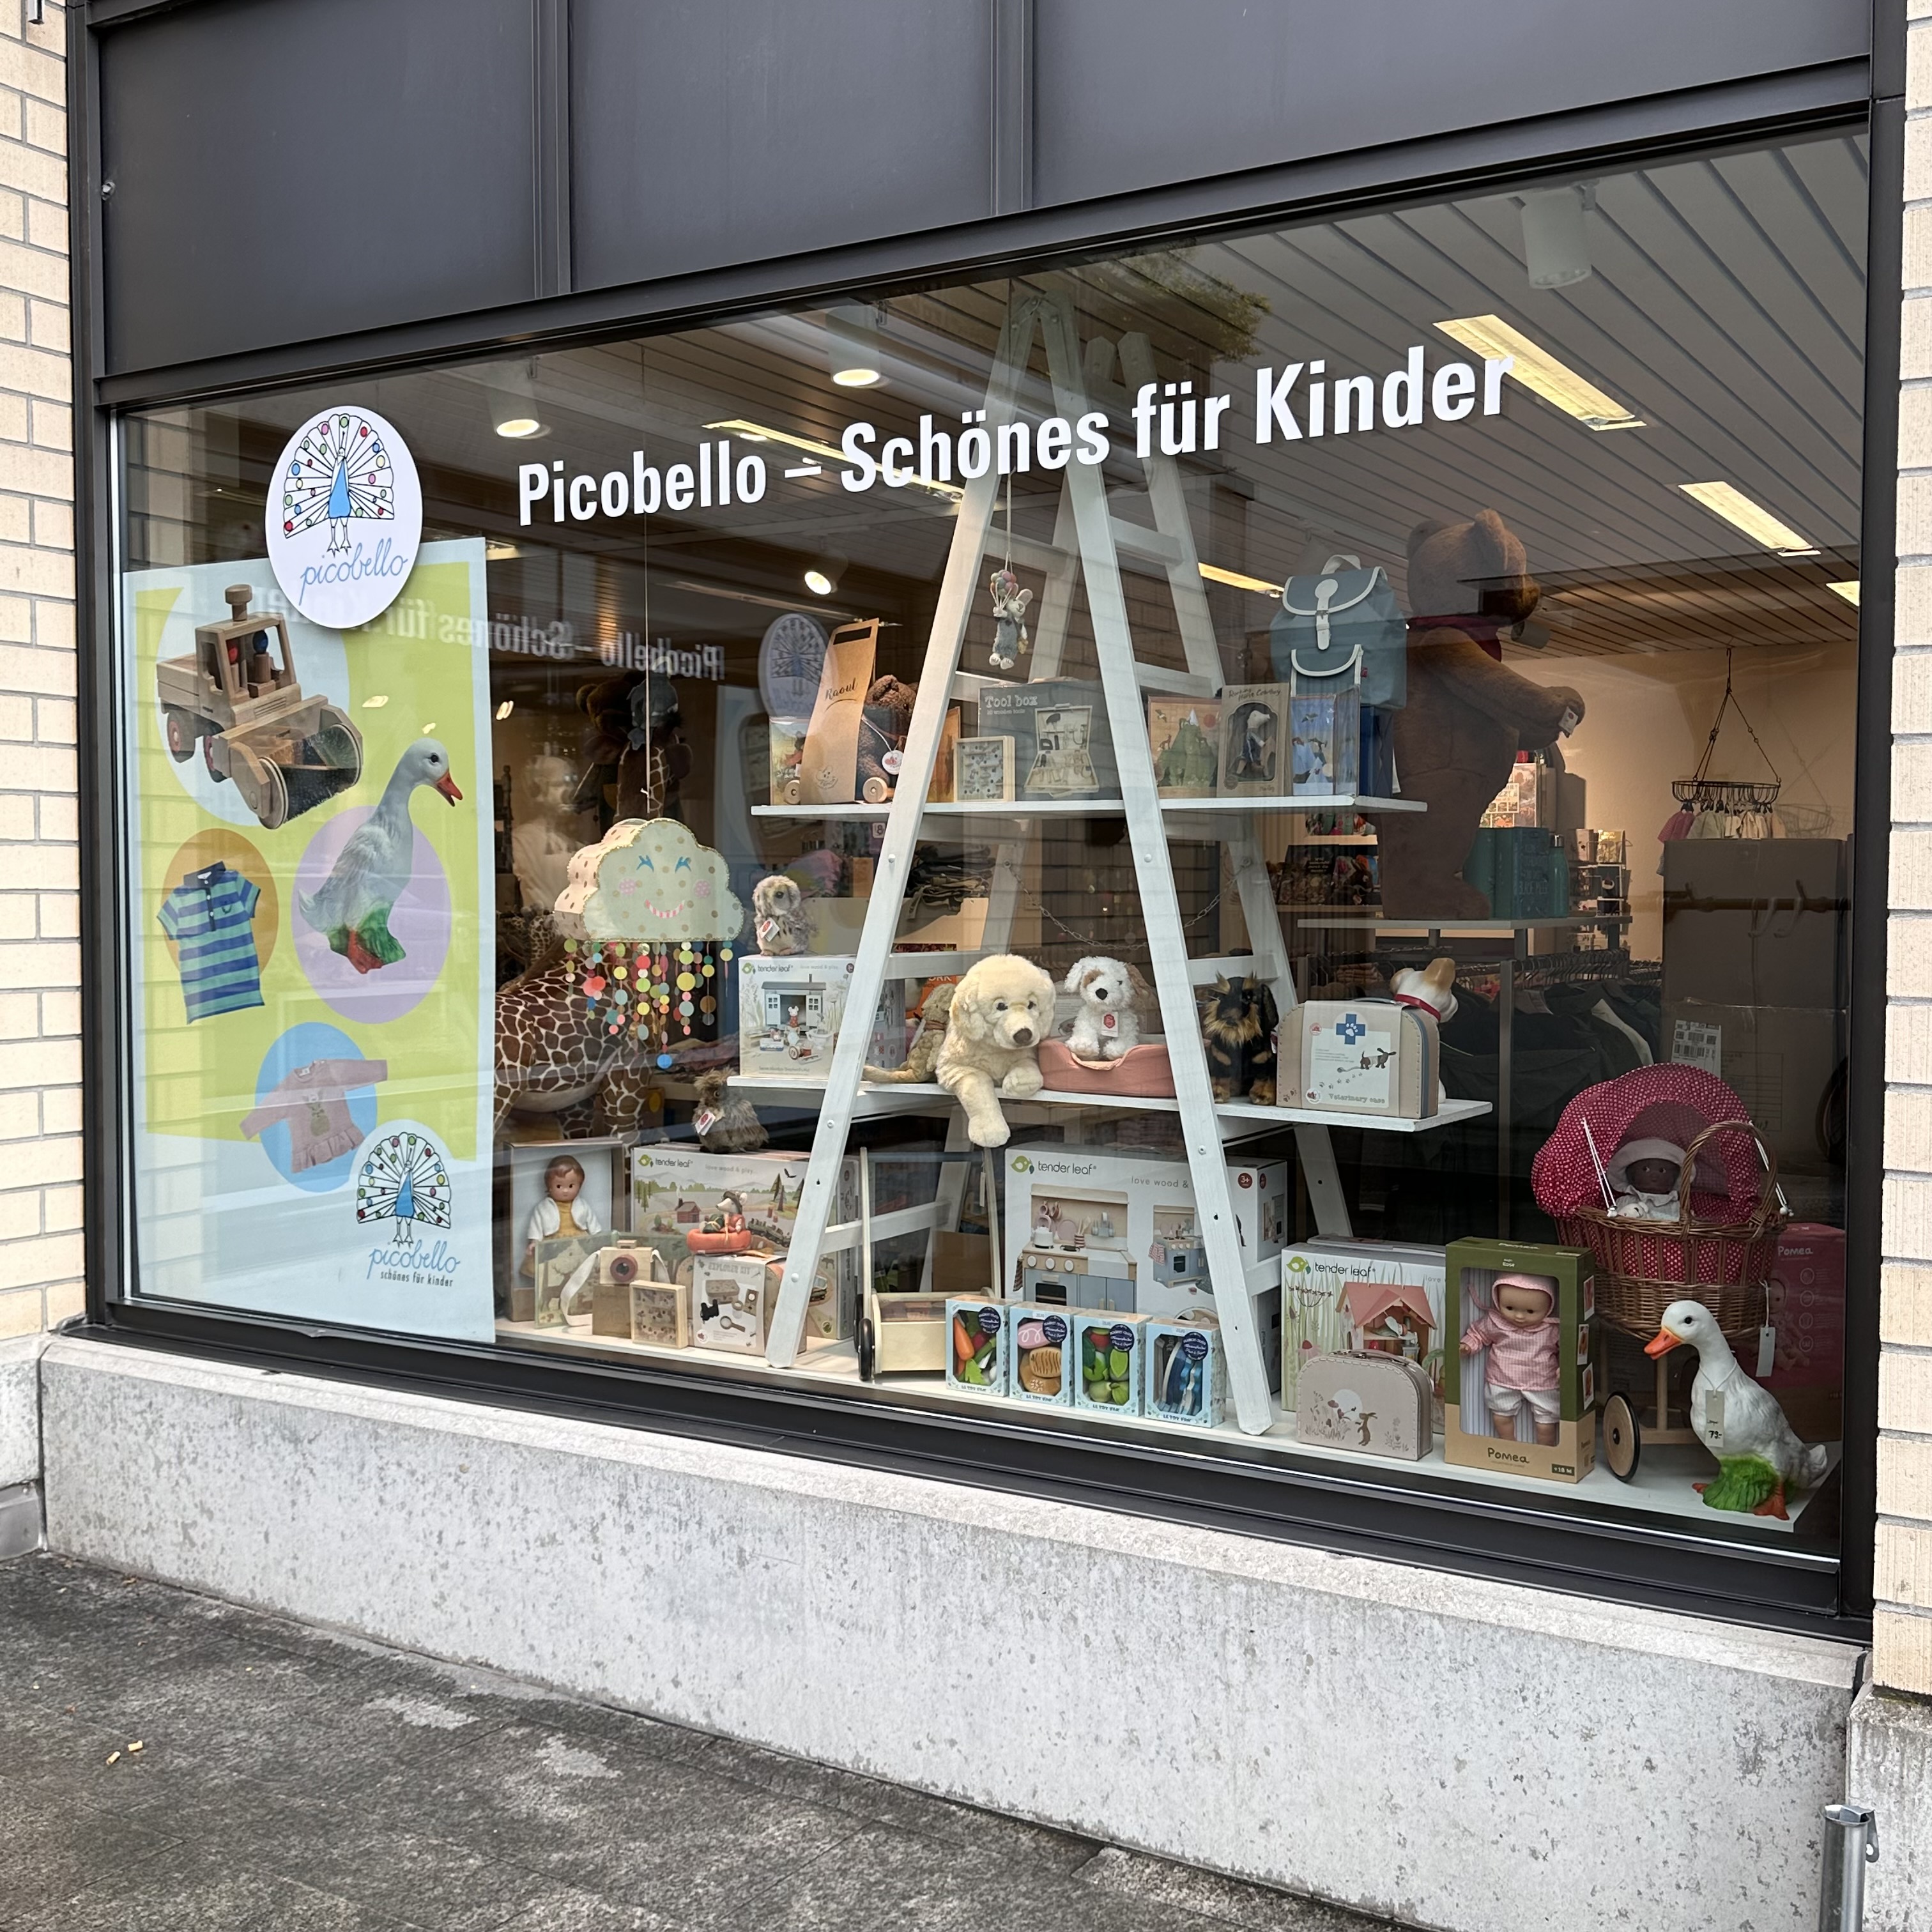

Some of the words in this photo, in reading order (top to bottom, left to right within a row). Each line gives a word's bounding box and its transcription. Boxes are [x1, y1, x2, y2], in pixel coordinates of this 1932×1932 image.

[518, 440, 766, 526] Picobello
[840, 409, 1110, 493] Schönes
[1132, 380, 1230, 458] für
[1256, 346, 1514, 445] Kinder
[298, 537, 409, 606] picobello
[825, 678, 857, 701] Raoul
[985, 694, 1012, 708] Tool
[1015, 694, 1038, 707] box
[656, 1158, 677, 1167] tender
[677, 1158, 691, 1168] leaf
[1038, 1161, 1071, 1174] tender
[1073, 1163, 1094, 1176] leaf
[1131, 1176, 1151, 1186] love
[1154, 1177, 1179, 1188] wood
[1182, 1179, 1189, 1188] &
[1778, 1246, 1813, 1256] Pomea
[367, 1239, 460, 1280] picobello
[1315, 1262, 1348, 1275] tender
[1351, 1264, 1372, 1277] leaf
[381, 1269, 410, 1282] schönes
[413, 1272, 425, 1284] für
[427, 1273, 453, 1287] kinder
[1487, 1447, 1530, 1464] Pomea
